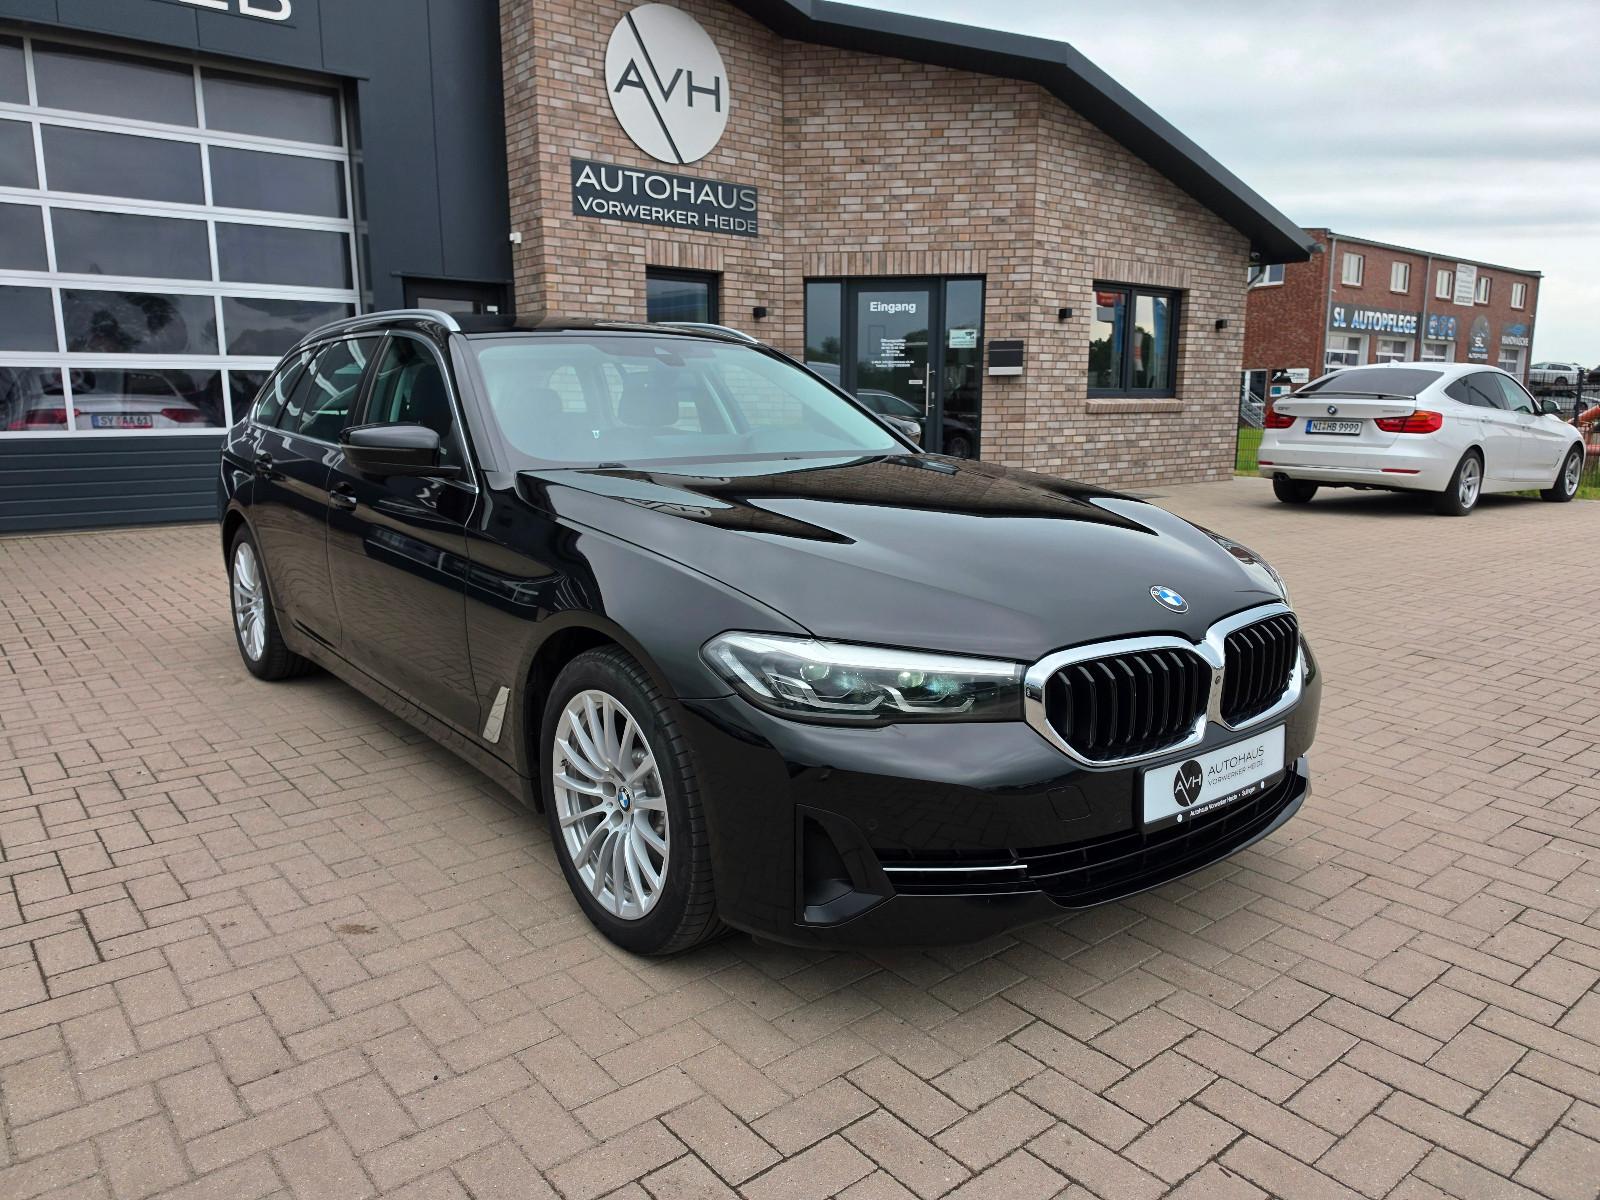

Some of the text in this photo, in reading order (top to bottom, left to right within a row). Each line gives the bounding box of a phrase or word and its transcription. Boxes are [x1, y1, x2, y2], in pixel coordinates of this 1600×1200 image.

[613, 58, 721, 113] AVH
[575, 165, 757, 212] AUTOHAUS
[577, 195, 757, 233] VORWERKER HEIDE
[869, 301, 916, 313] Eingang
[1333, 307, 1417, 334] SL AUTOPFLEGE
[101, 416, 114, 425] SY
[1312, 422, 1360, 433] NI HB 9999
[1207, 745, 1264, 776] AUTOHAUS
